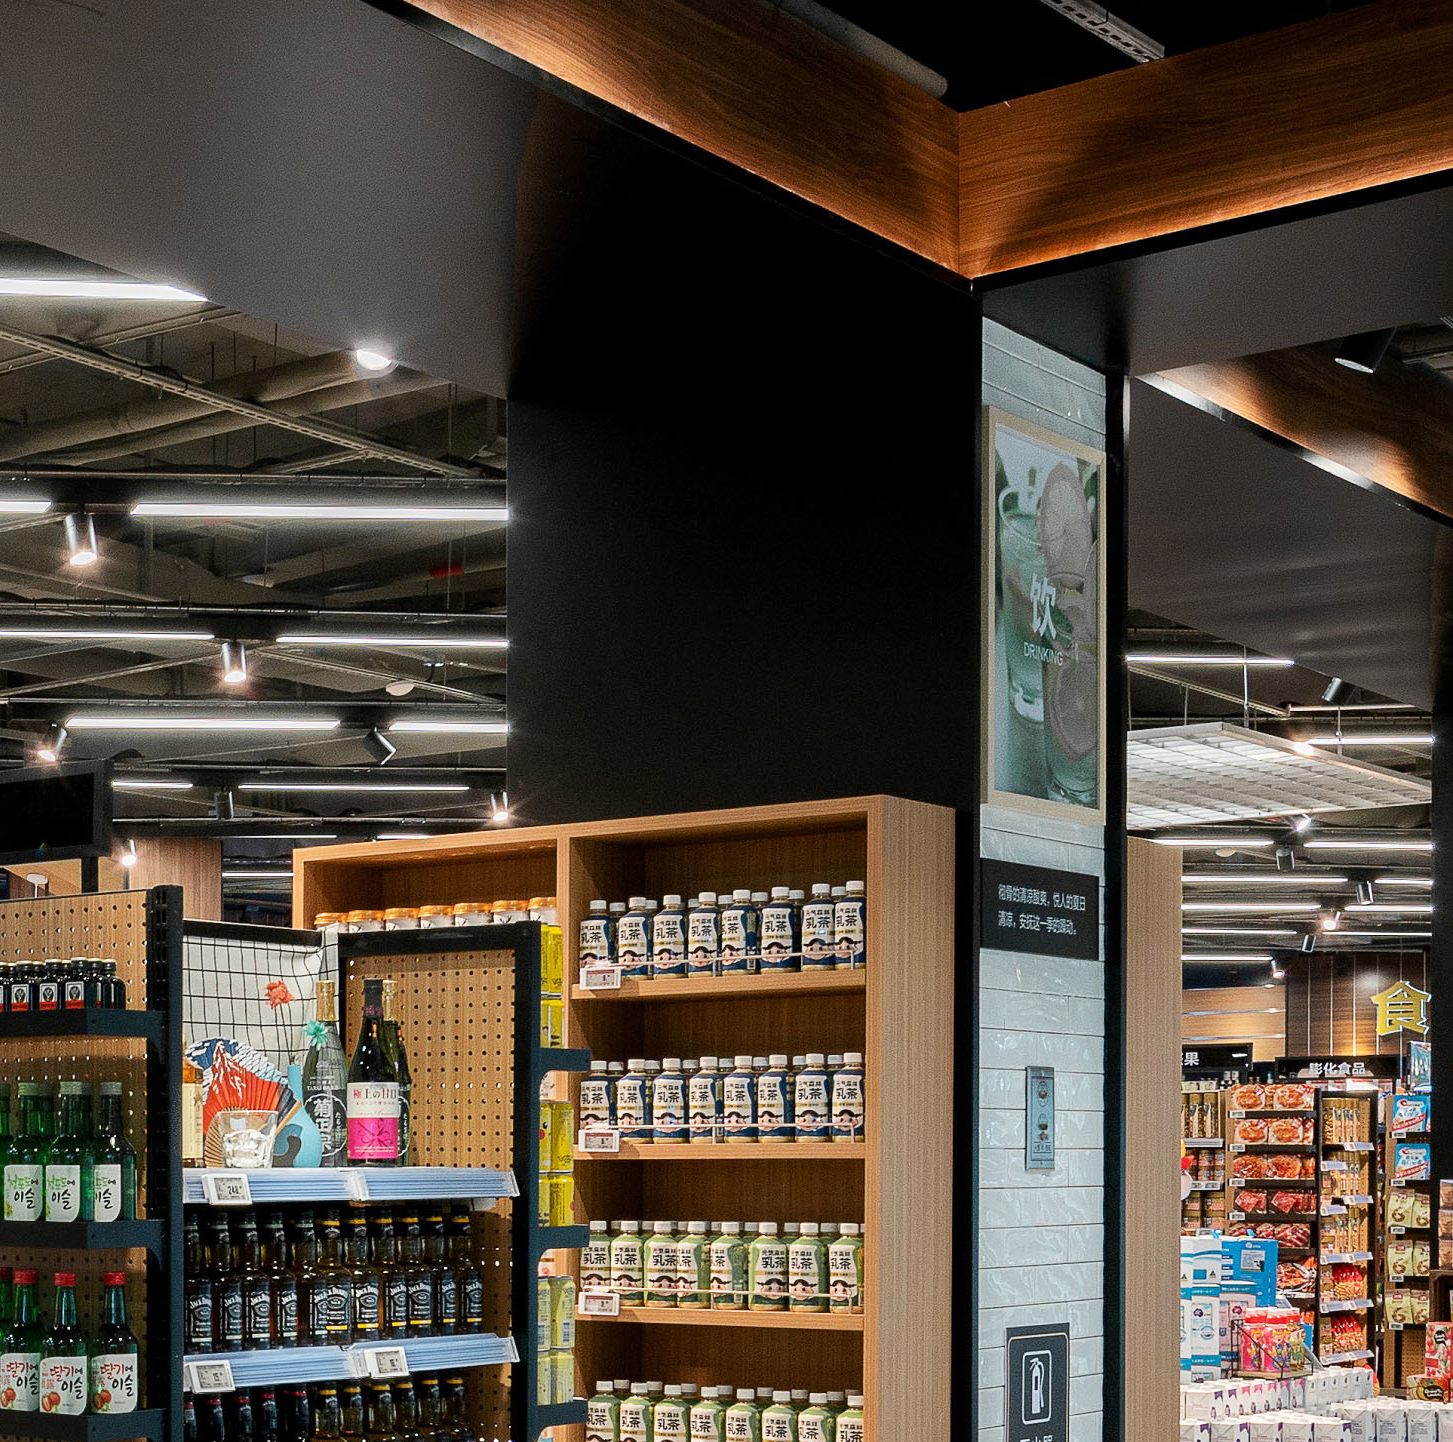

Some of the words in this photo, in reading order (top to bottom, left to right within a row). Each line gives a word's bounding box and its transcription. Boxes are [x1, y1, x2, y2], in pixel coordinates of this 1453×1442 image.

[1030, 572, 1057, 641] 饮
[1023, 641, 1064, 667] DRINKING
[765, 921, 787, 933] 乳茶
[806, 917, 831, 929] 乳茶
[836, 915, 857, 928] 乳茶
[656, 926, 678, 939] 乳茶
[1370, 980, 1432, 1037] 食
[1308, 1061, 1366, 1076] 膨化食品
[658, 1092, 679, 1104] 乳茶
[799, 1088, 822, 1101] 乳茶
[836, 1088, 857, 1100] 乳茶
[13, 1188, 36, 1210] 이슬
[51, 1188, 73, 1210] 이슬
[761, 1256, 787, 1269] 乳茶
[50, 1364, 83, 1382] 딸기에
[100, 1363, 134, 1381] 딸기에
[61, 1376, 84, 1400] 이슬
[111, 1375, 134, 1397] 이슬
[657, 1416, 680, 1431] 乳茶
[765, 1424, 788, 1439] 乳茶
